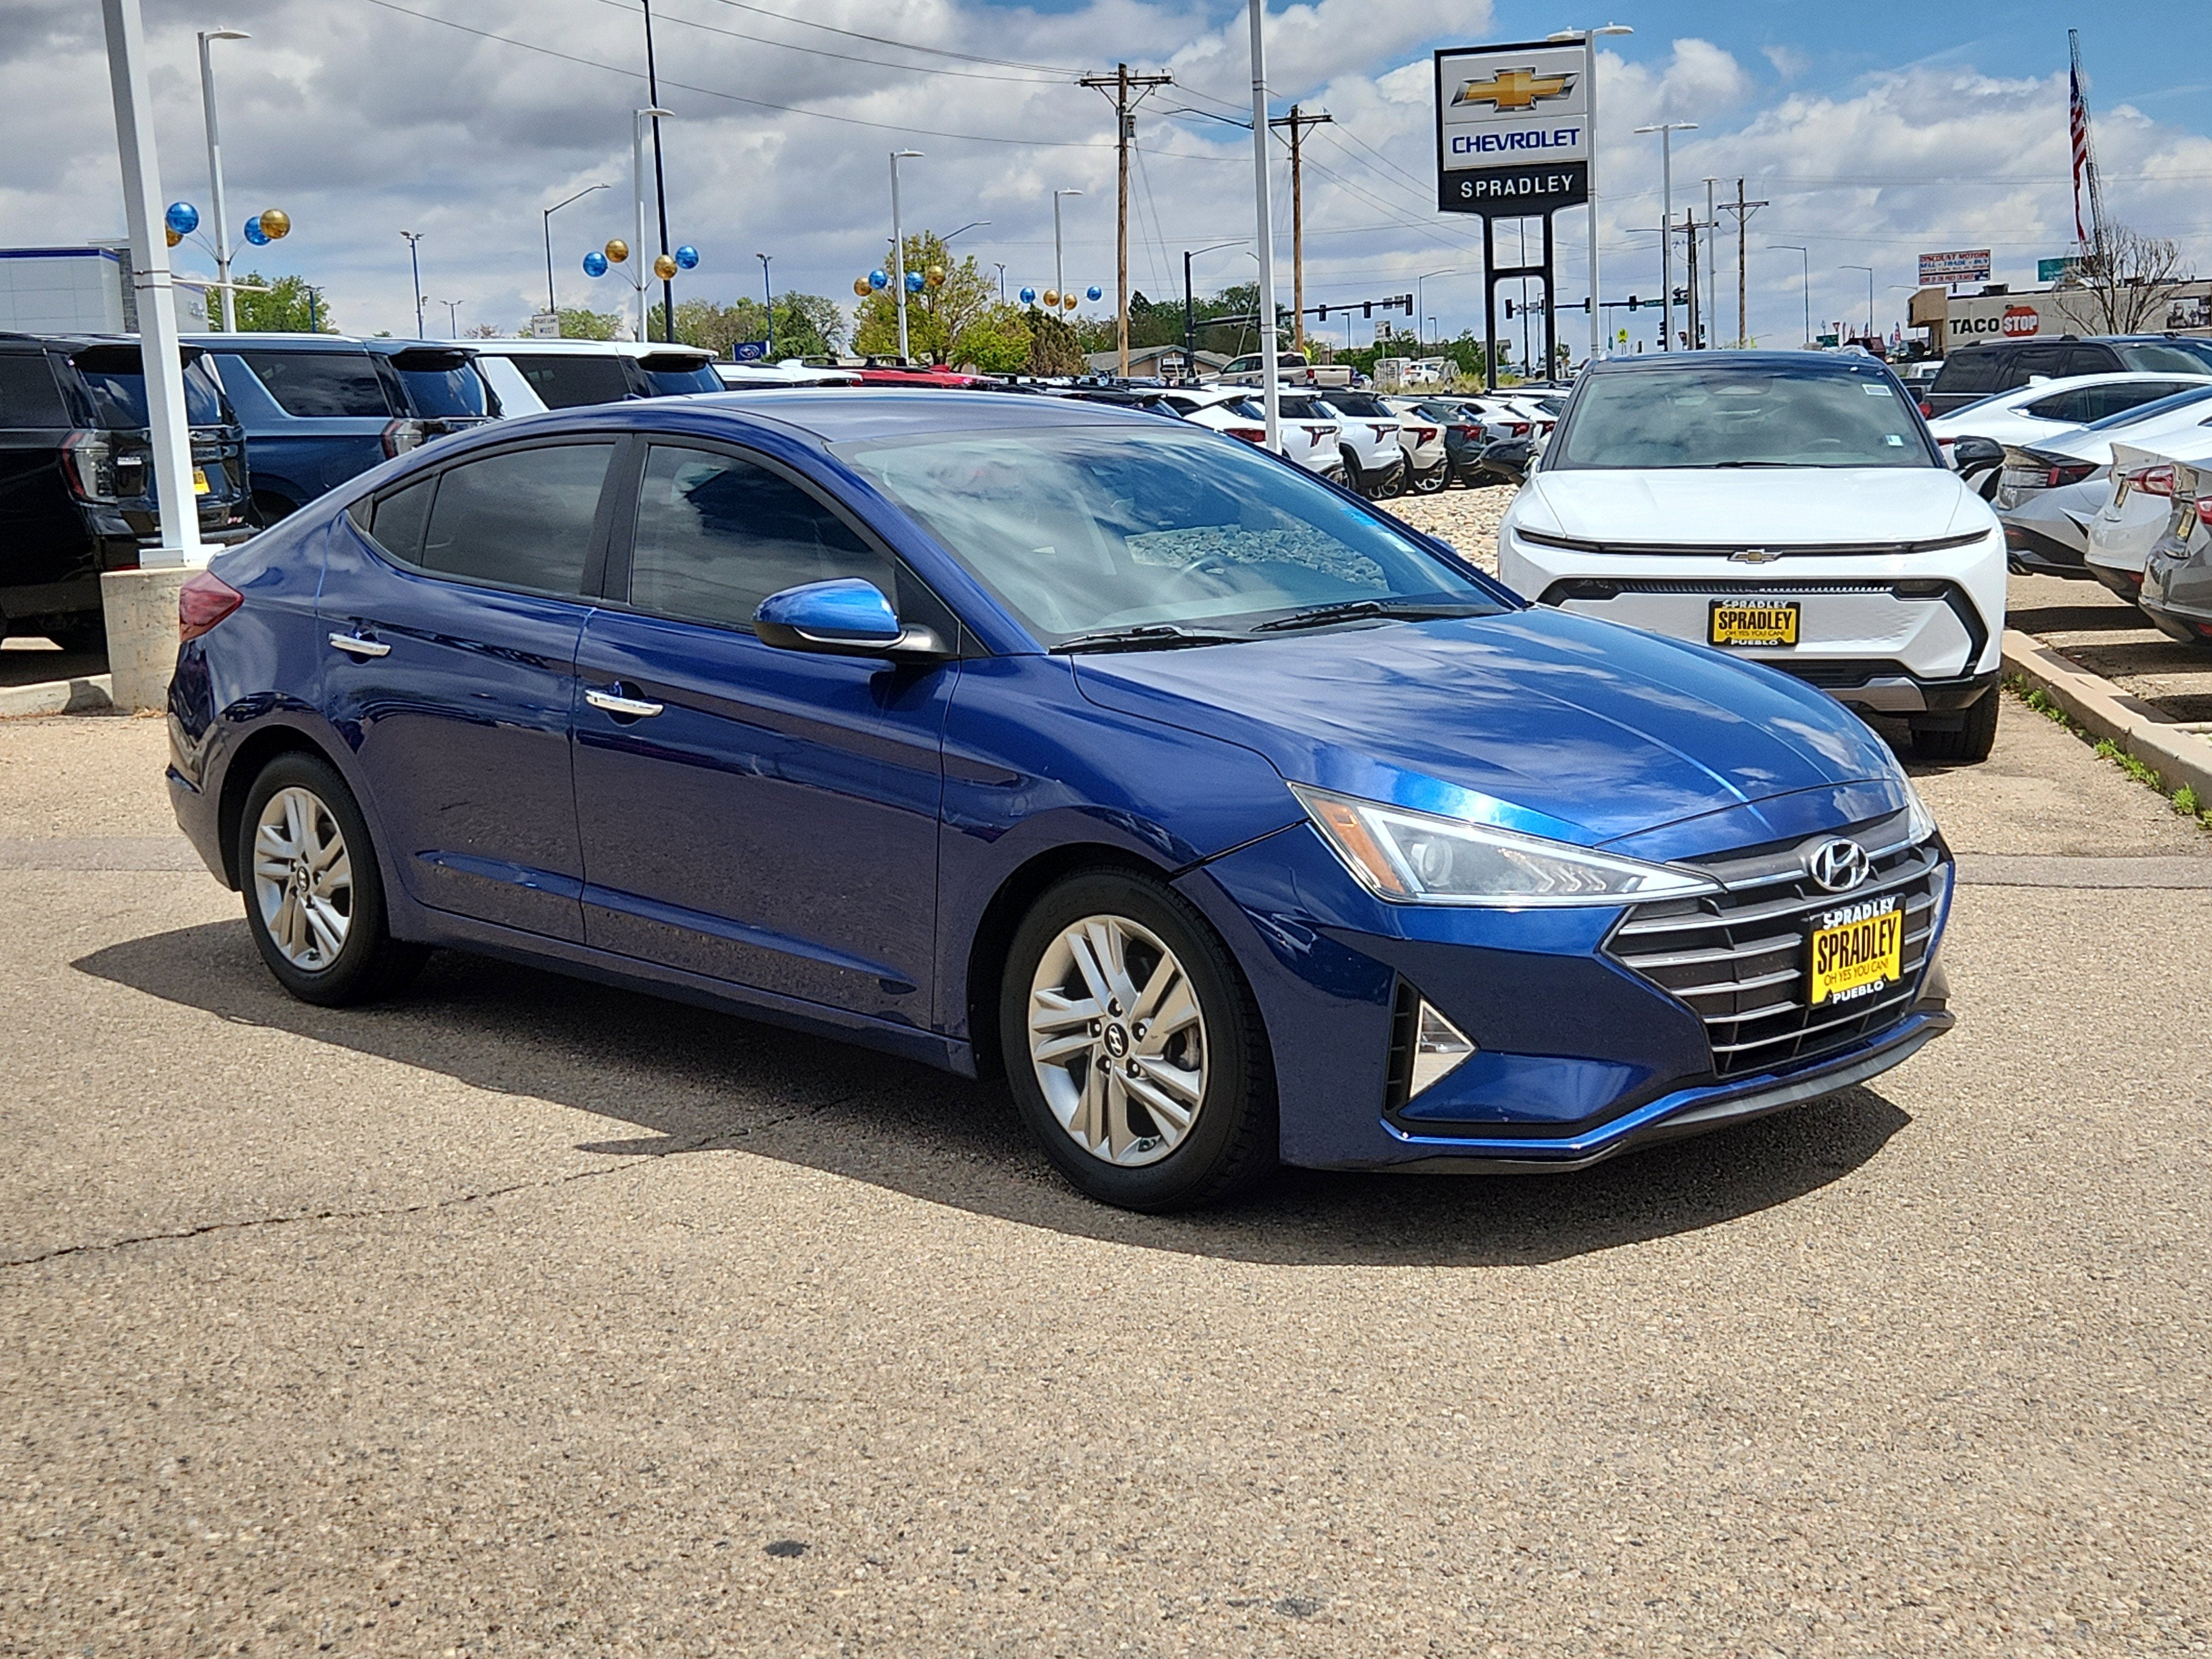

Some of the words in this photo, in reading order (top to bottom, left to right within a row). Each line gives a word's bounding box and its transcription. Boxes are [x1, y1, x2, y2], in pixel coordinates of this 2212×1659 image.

[1452, 128, 1580, 154] CHEVROLET
[1461, 174, 1574, 198] SPRADLEY
[1949, 318, 1999, 334] TACO
[2003, 315, 2037, 332] STOP
[1722, 600, 1789, 609] SPRADLEY
[1719, 611, 1792, 629] SPRADLEY
[1823, 897, 1896, 930] SPRADLEY
[1817, 916, 1897, 975] SPRADLEY
[1824, 972, 1837, 986] OH
[1839, 968, 1851, 982] YES
[1854, 963, 1870, 978] YOU
[1832, 980, 1885, 1004] PUEBLO
